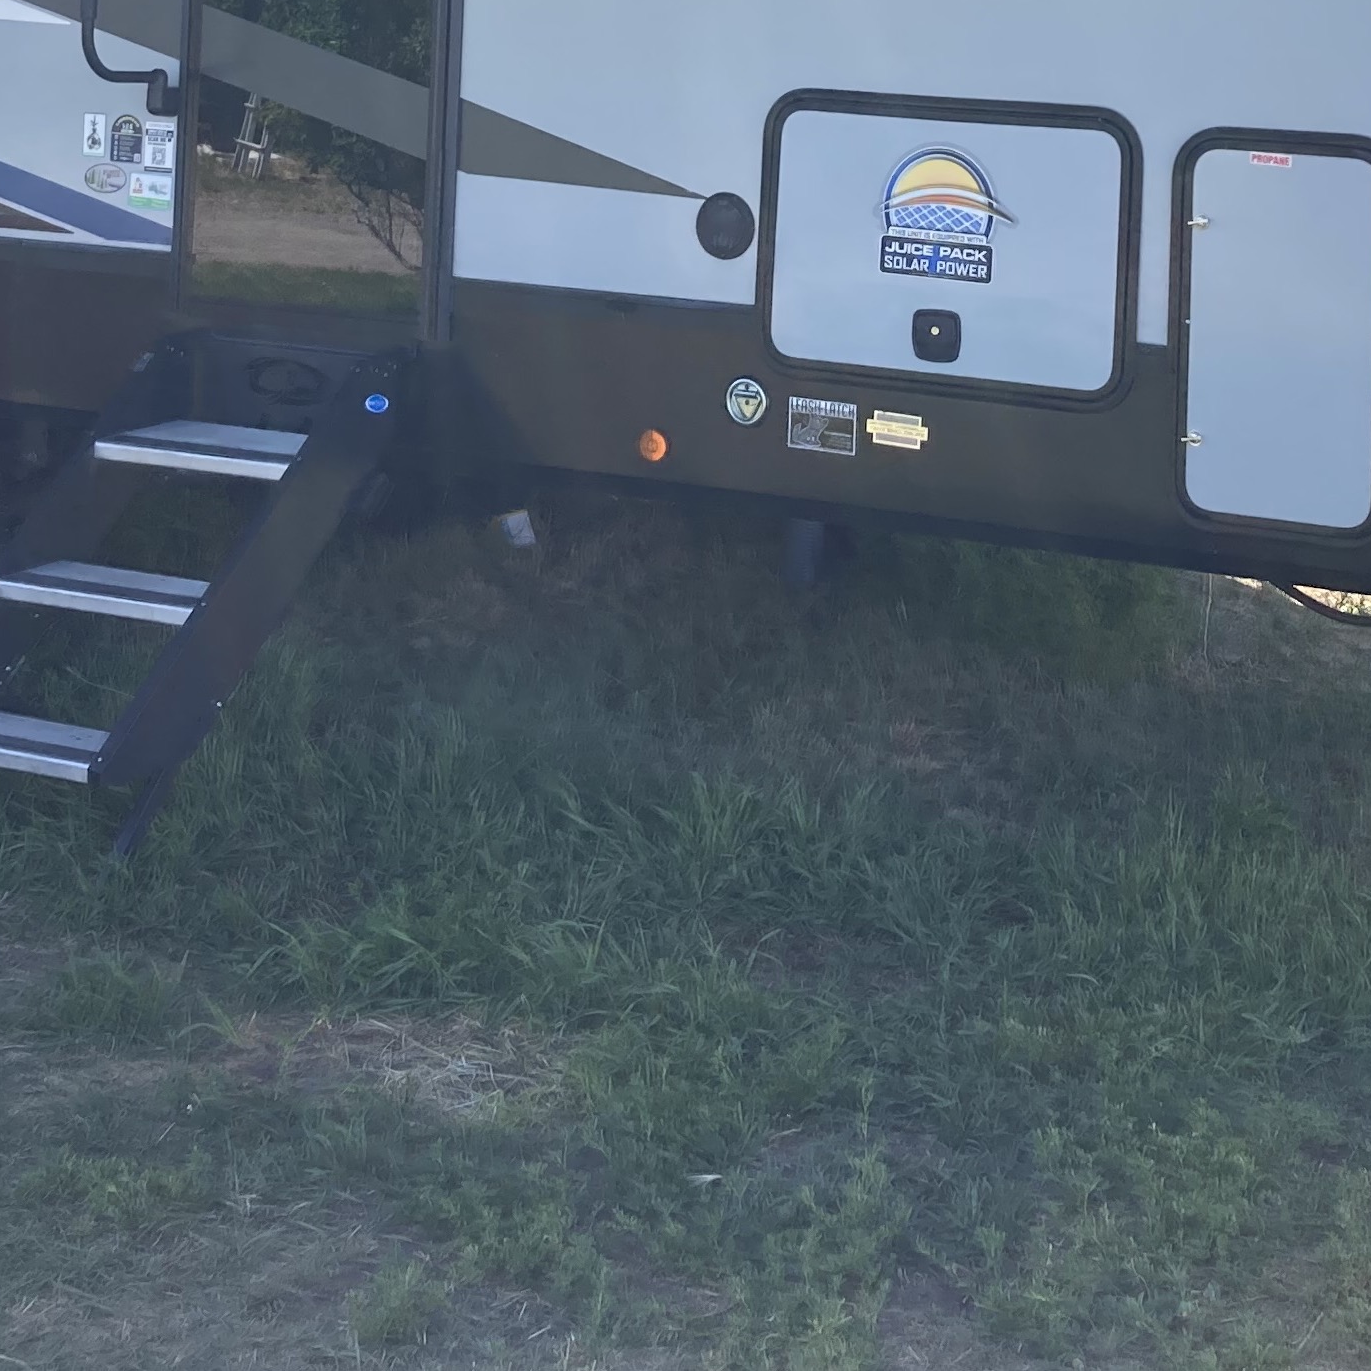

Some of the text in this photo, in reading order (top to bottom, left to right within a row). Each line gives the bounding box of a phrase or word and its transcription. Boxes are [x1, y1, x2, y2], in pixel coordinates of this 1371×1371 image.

[1251, 153, 1290, 166] PROPANE
[884, 241, 987, 262] JUICE PACK
[883, 254, 987, 279] SOLAR POWER
